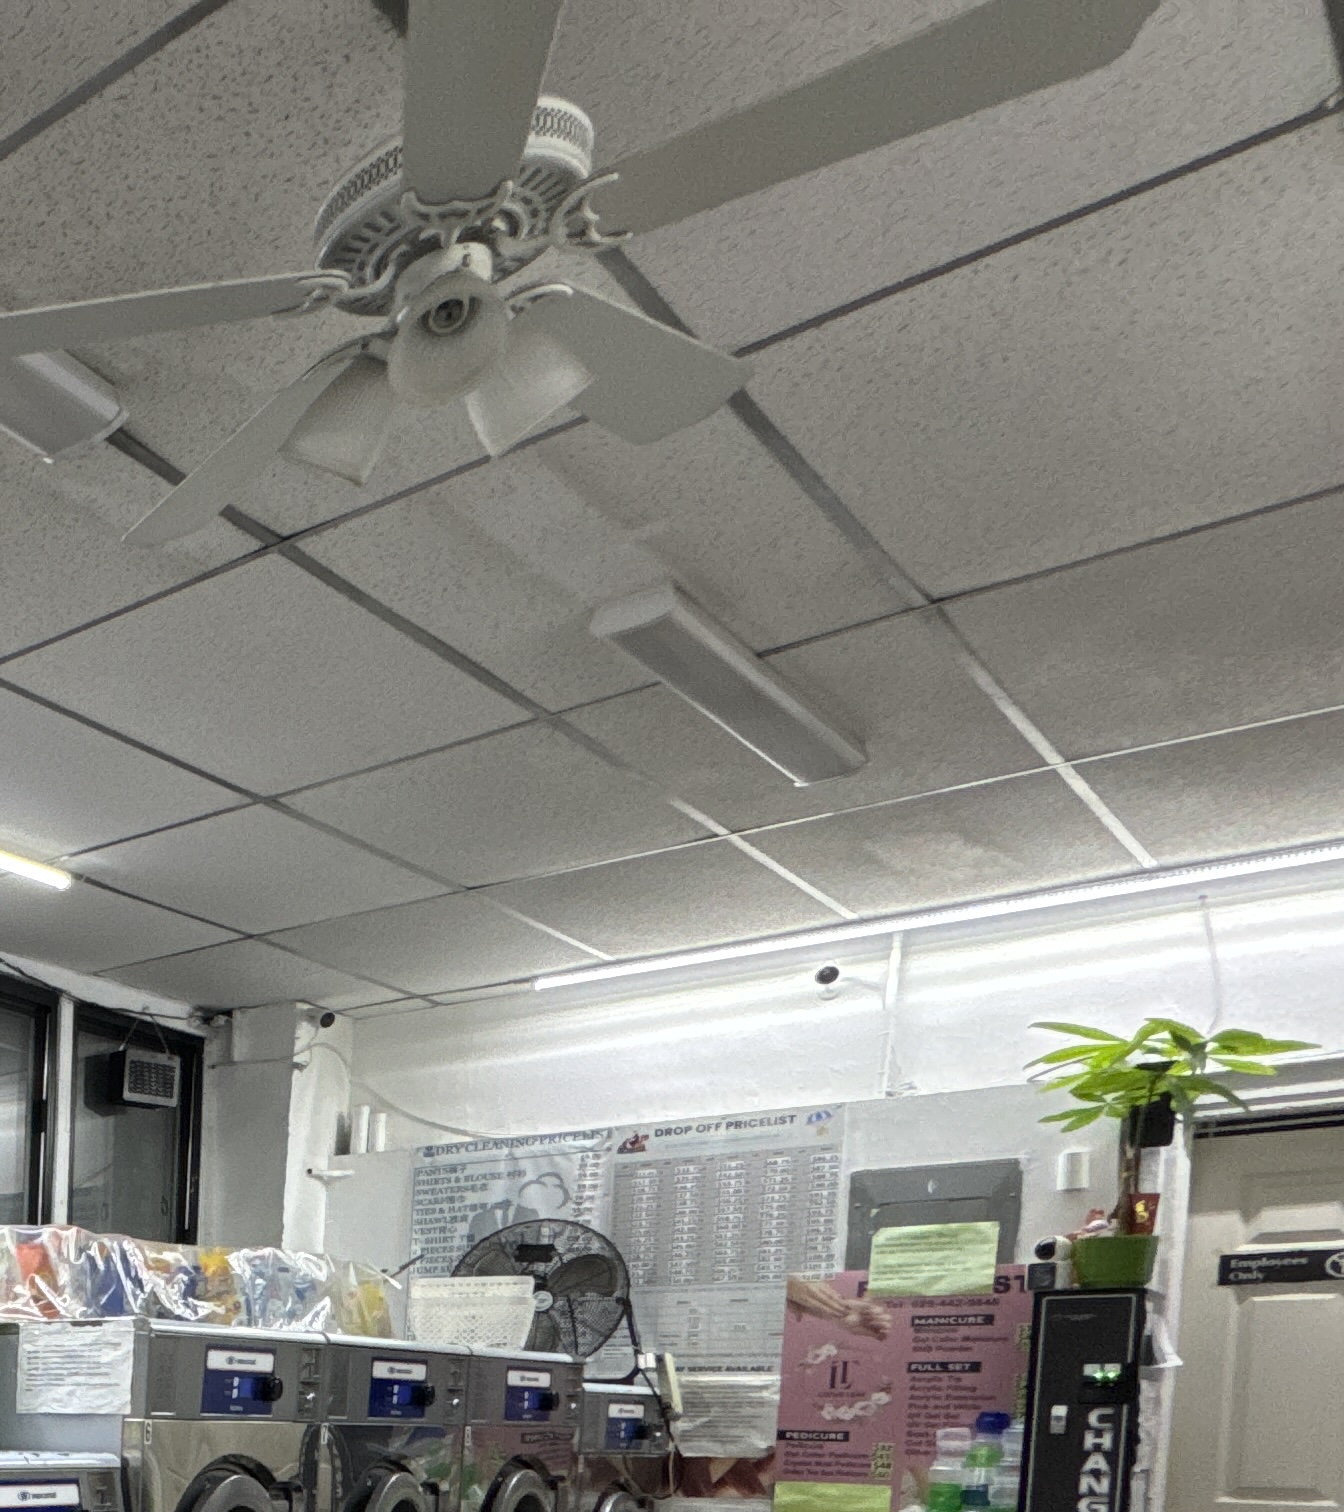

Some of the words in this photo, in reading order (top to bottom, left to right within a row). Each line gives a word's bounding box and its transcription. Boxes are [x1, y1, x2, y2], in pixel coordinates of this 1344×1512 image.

[654, 1124, 693, 1139] DROP
[695, 1121, 723, 1134] OFF
[724, 1113, 798, 1131] PRICELIST
[435, 1143, 462, 1157] DRY
[463, 1135, 535, 1154] CLEANING
[1230, 1256, 1309, 1270] Employees
[914, 1315, 985, 1325] MANICURE
[910, 1363, 943, 1371] FULL
[947, 1363, 972, 1371] SET
[785, 1431, 845, 1440] PEDICURE
